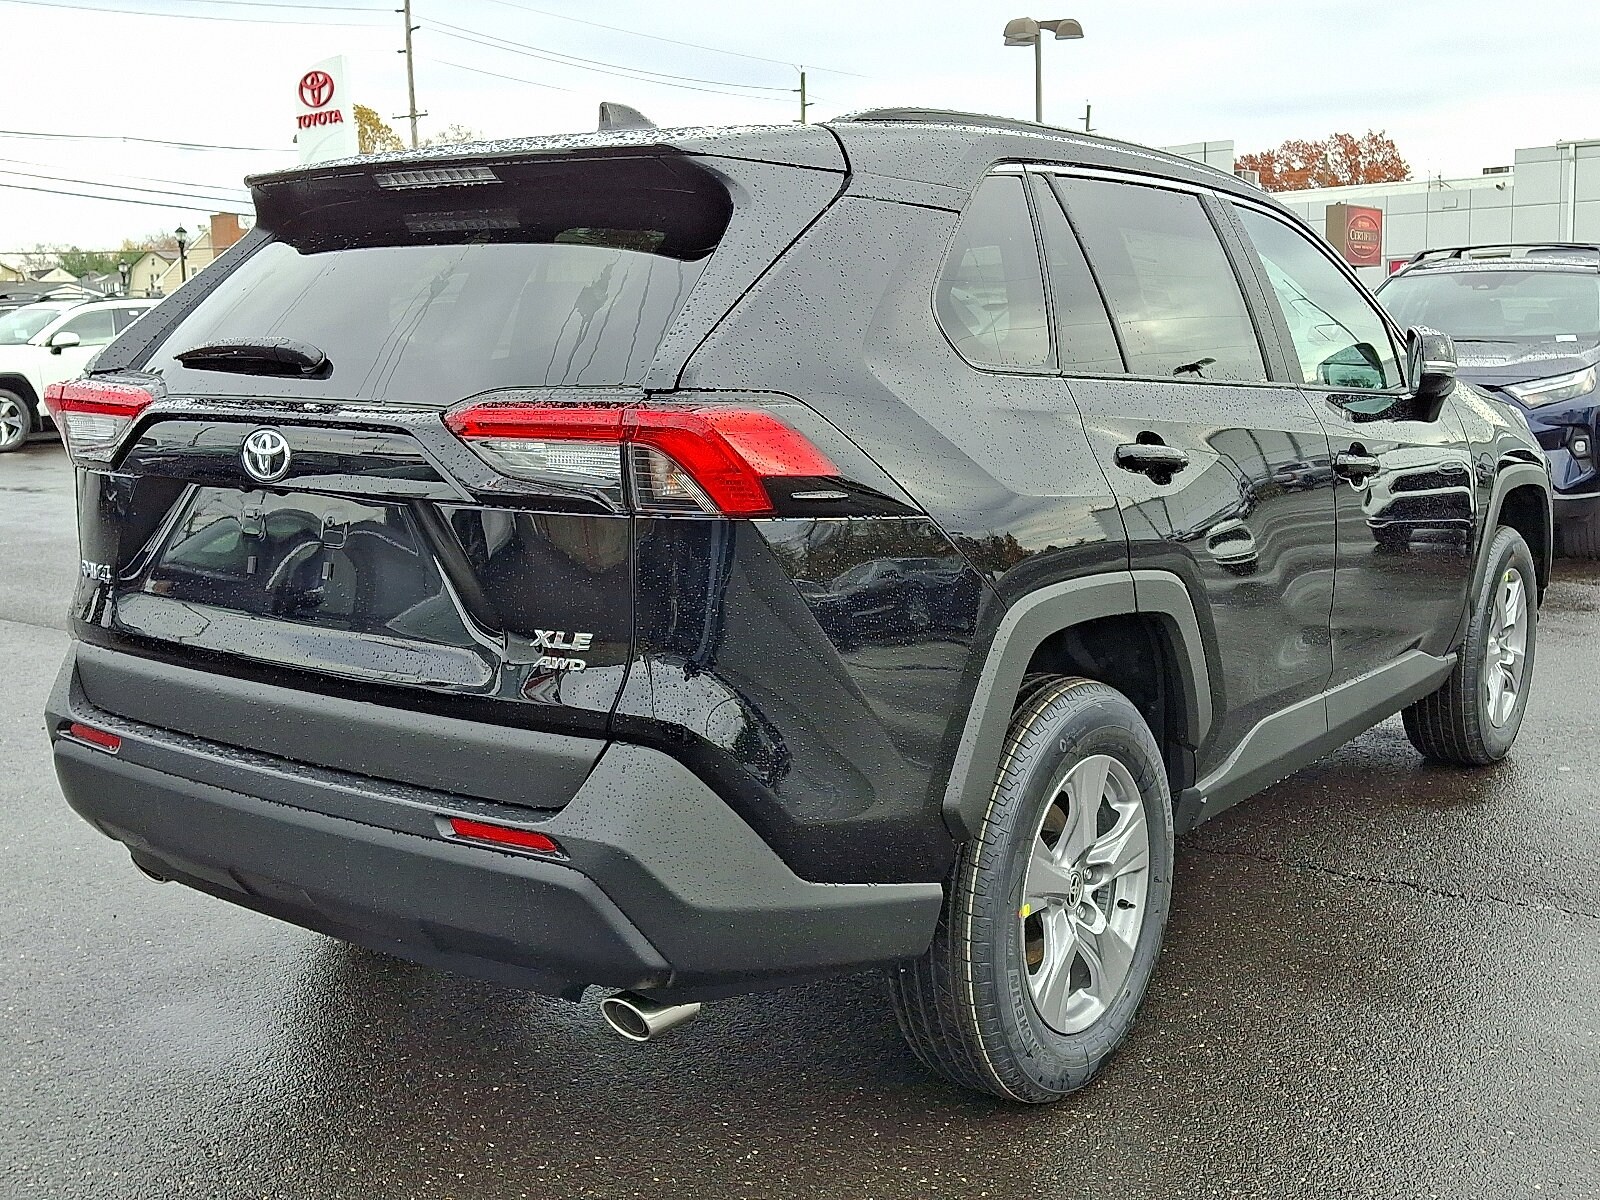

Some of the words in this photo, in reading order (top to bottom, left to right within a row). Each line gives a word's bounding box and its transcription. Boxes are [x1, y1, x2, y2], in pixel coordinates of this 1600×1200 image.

[296, 109, 344, 129] TOYOTA
[530, 629, 593, 651] XLE
[533, 656, 586, 670] AWD
